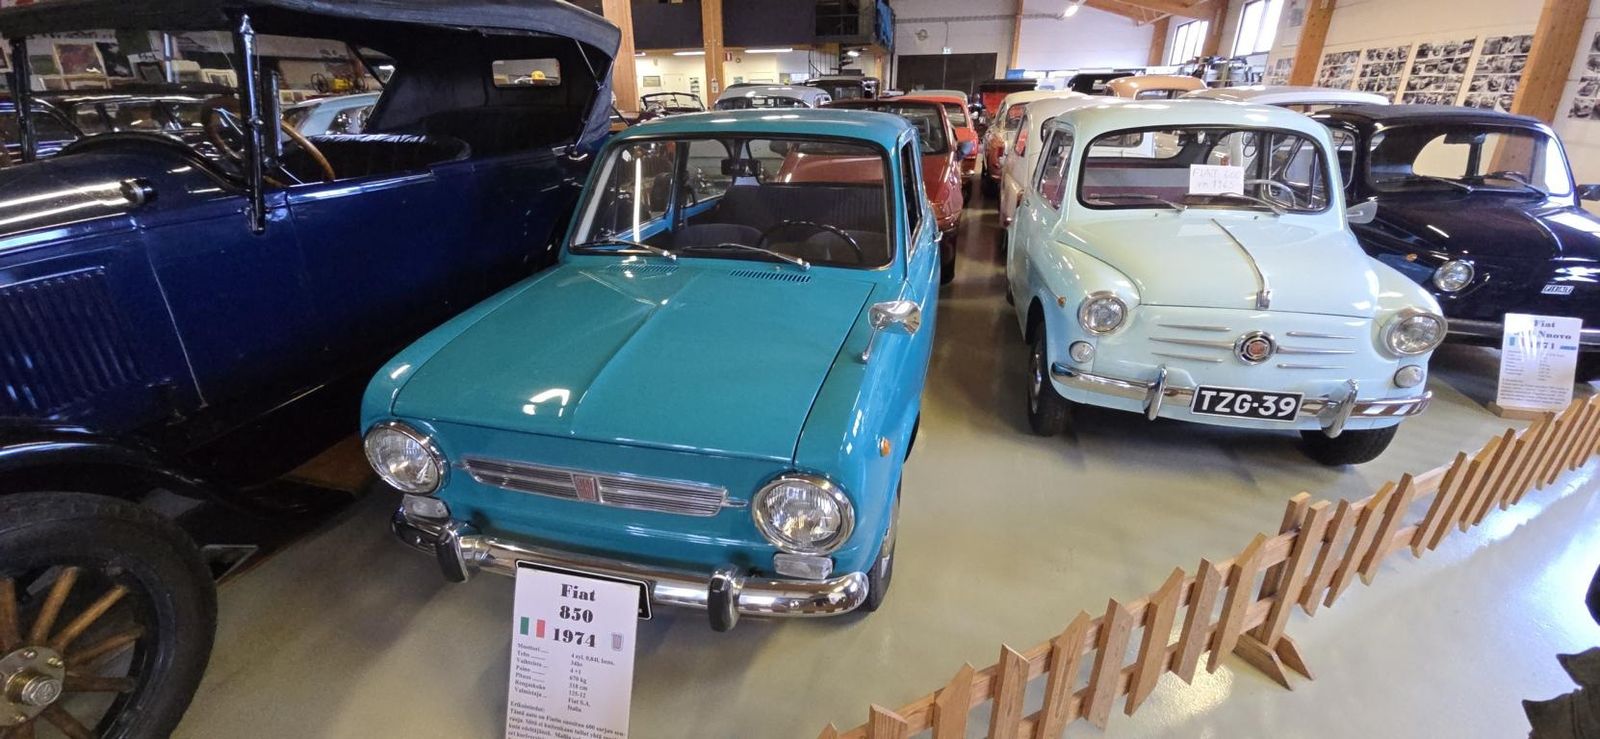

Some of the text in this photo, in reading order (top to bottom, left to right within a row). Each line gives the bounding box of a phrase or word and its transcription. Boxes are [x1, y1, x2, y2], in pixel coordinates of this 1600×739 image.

[1200, 390, 1297, 417] TZG-39
[561, 583, 596, 602] Fiat
[559, 605, 594, 624] 850
[553, 627, 596, 648] 1974
